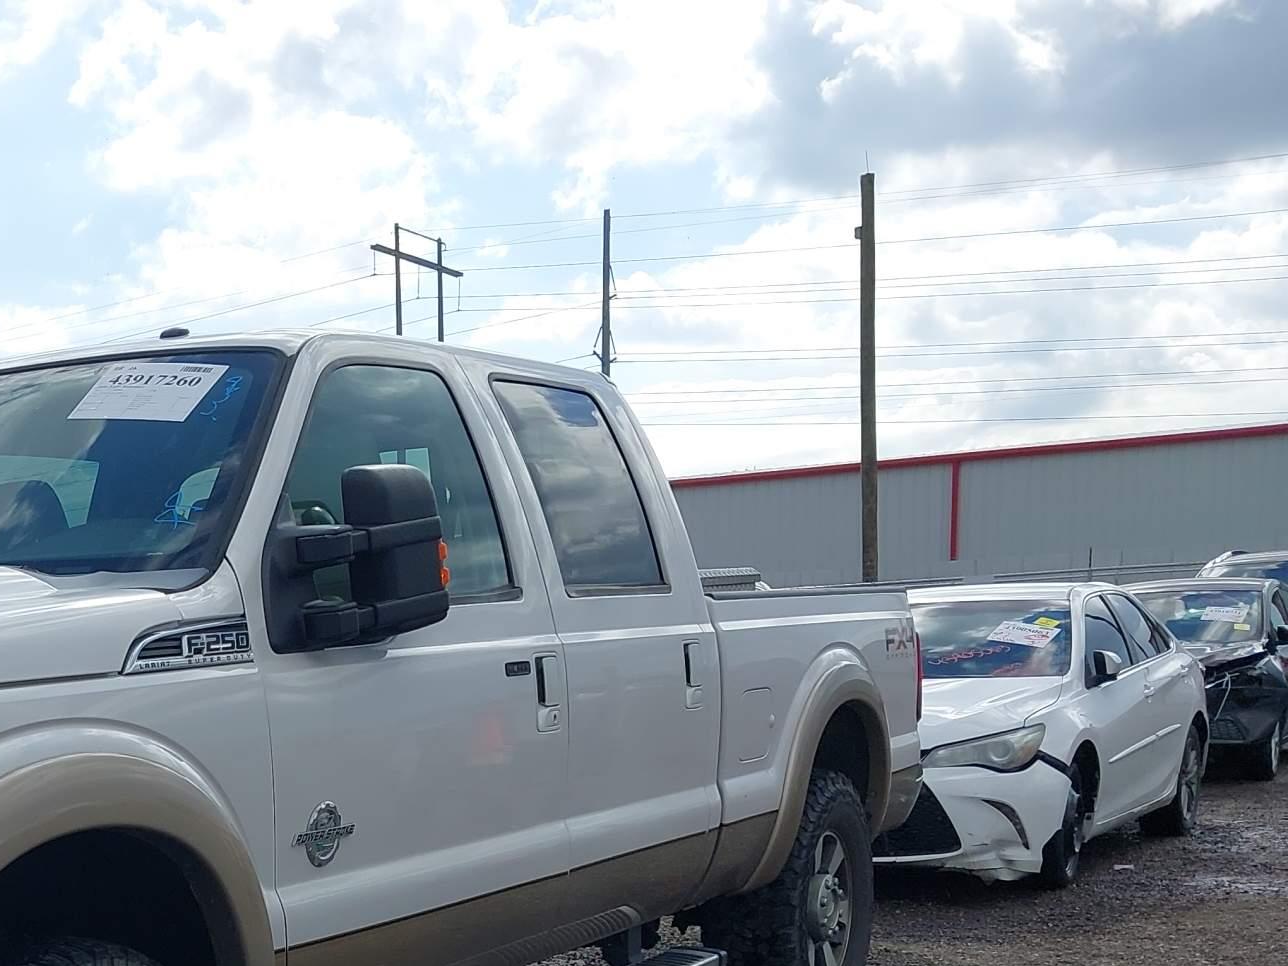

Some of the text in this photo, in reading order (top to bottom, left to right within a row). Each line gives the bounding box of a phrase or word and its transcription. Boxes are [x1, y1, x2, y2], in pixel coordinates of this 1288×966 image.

[109, 374, 202, 387] 43917260
[884, 627, 916, 652] FX4
[138, 660, 171, 670] LARIAT
[187, 656, 222, 664] SUPER
